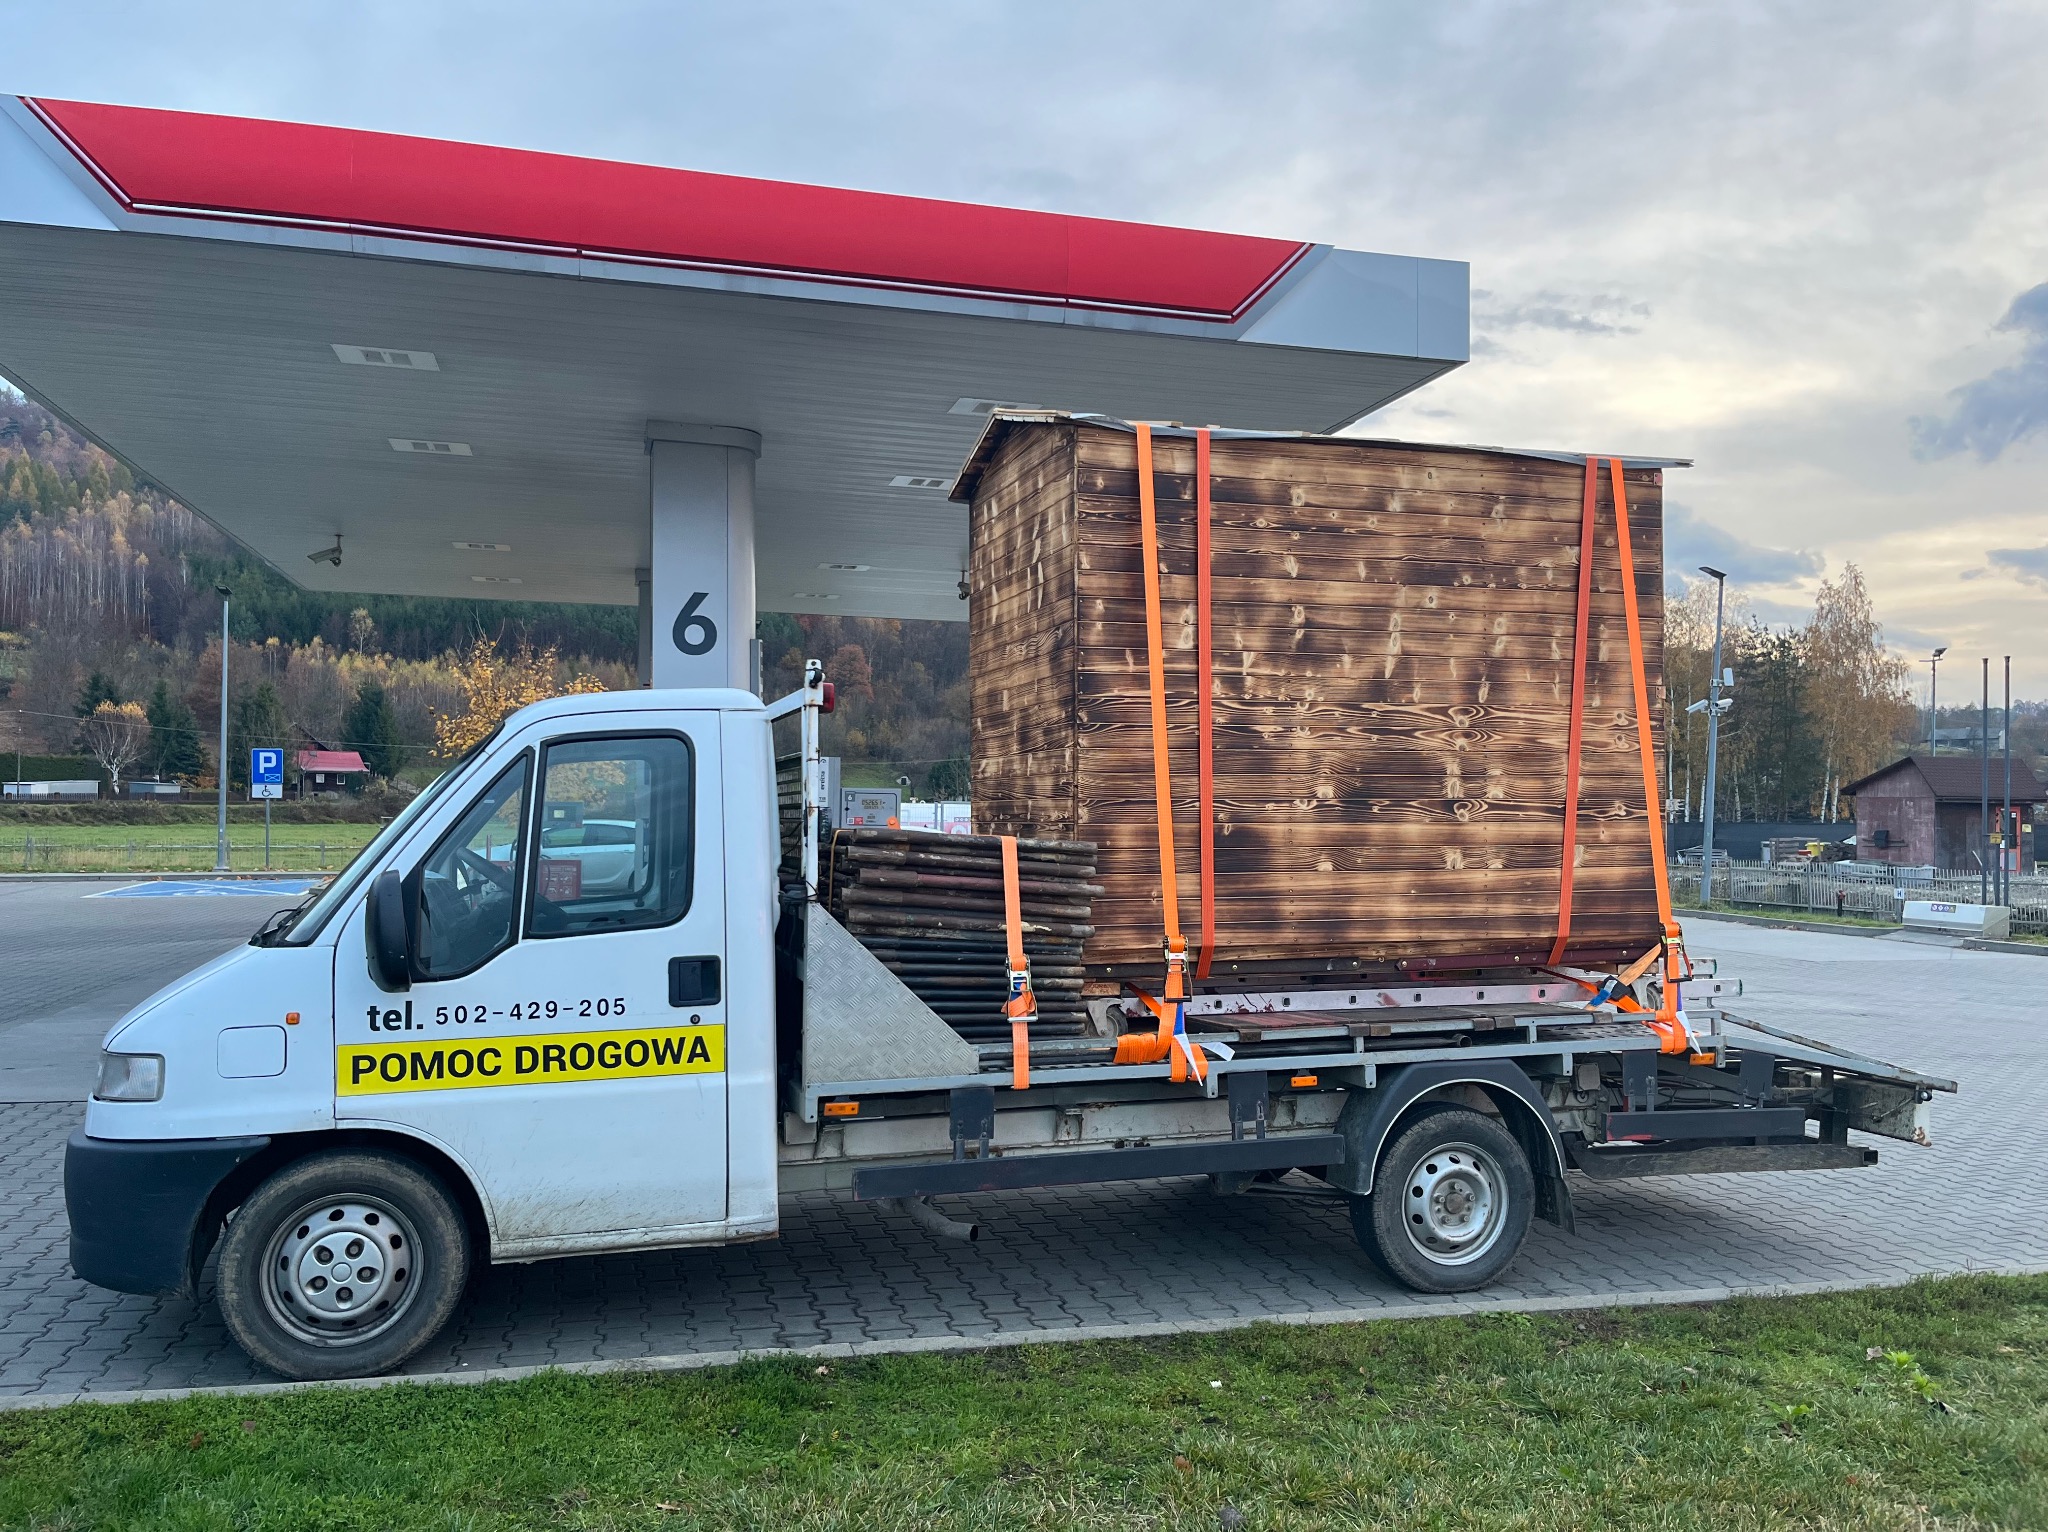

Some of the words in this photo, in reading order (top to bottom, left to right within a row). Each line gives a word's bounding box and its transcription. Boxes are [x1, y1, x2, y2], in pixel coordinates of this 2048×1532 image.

[672, 591, 718, 656] 6
[259, 751, 277, 774] P
[366, 1001, 424, 1031] tel.
[435, 997, 626, 1025] 502-429-205
[352, 1047, 502, 1085] POMOC
[515, 1035, 711, 1074] DROGOWA
